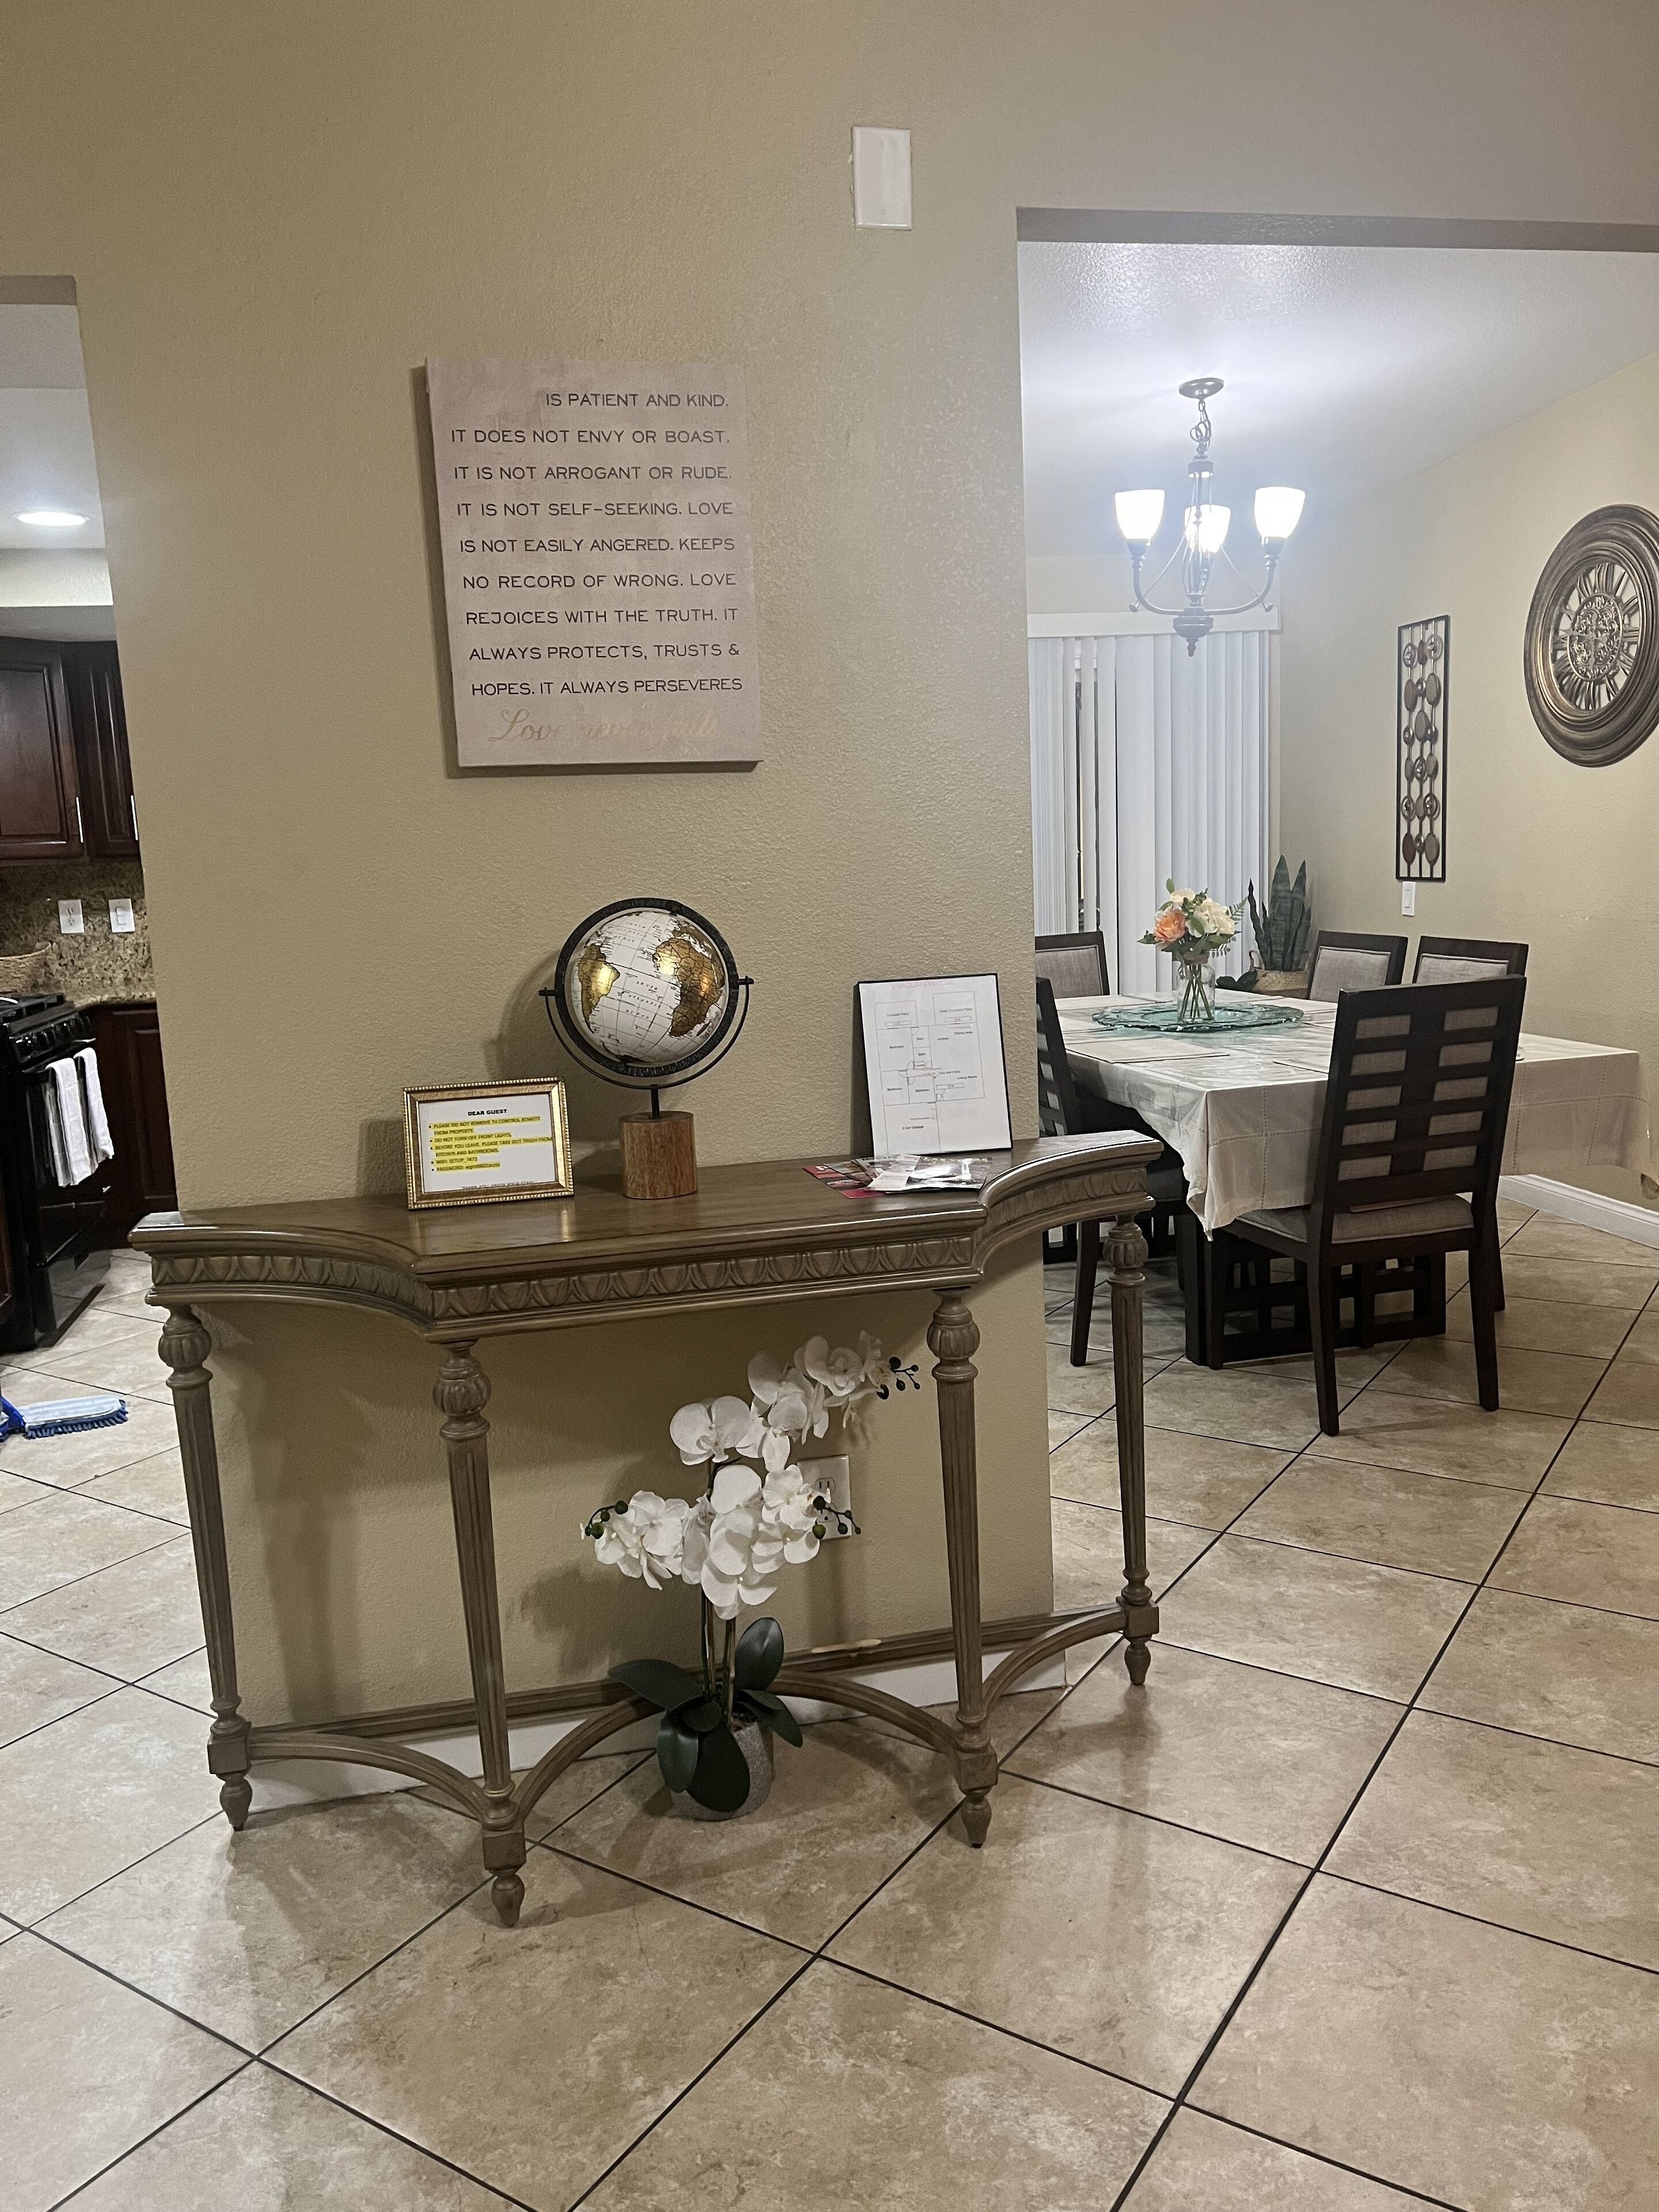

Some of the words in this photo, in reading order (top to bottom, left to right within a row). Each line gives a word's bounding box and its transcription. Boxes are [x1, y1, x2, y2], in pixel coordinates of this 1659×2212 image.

[546, 393, 562, 407] IS
[568, 393, 639, 407] PATIENT
[646, 393, 681, 407] AND
[687, 393, 729, 407] KIND.
[452, 429, 467, 443] IT
[474, 430, 526, 444] DOES
[533, 430, 570, 444] NOT
[577, 430, 624, 443] ENVY
[632, 430, 657, 444] OR
[665, 430, 730, 444] BOAST.
[454, 466, 469, 480] IT
[476, 466, 493, 480] IS
[499, 466, 537, 480] NOT
[544, 466, 641, 480] ARROGANT
[649, 466, 673, 480] OR
[681, 466, 732, 479] RUDE.
[457, 503, 472, 516] IT
[481, 503, 498, 517] IS
[503, 502, 541, 516] NOT
[548, 502, 683, 516] SELF-SEEKING.
[688, 502, 733, 515] LOVE
[460, 540, 476, 553] IS
[482, 539, 518, 552] NOT
[524, 538, 584, 552] EASILY
[589, 538, 674, 552] ANGERED.
[679, 537, 735, 551] KEEPS
[463, 575, 489, 589] NO
[498, 575, 575, 589] RECORD
[583, 575, 607, 588] OF
[613, 574, 683, 588] WRONG.
[690, 573, 737, 586] LOVE
[466, 611, 559, 625] REJOICES
[564, 610, 607, 623] WITH
[613, 609, 649, 623] THE
[655, 608, 718, 622] TRUTH.
[724, 608, 738, 621] IT
[469, 646, 541, 661] ALWAYS
[547, 645, 647, 661] PROTECTS,
[653, 643, 722, 657] TRUSTS
[728, 643, 740, 656] &
[472, 683, 535, 696] HOPES.
[540, 681, 554, 695] IT
[560, 680, 629, 694] ALWAYS
[634, 678, 743, 692] PERSEVERES
